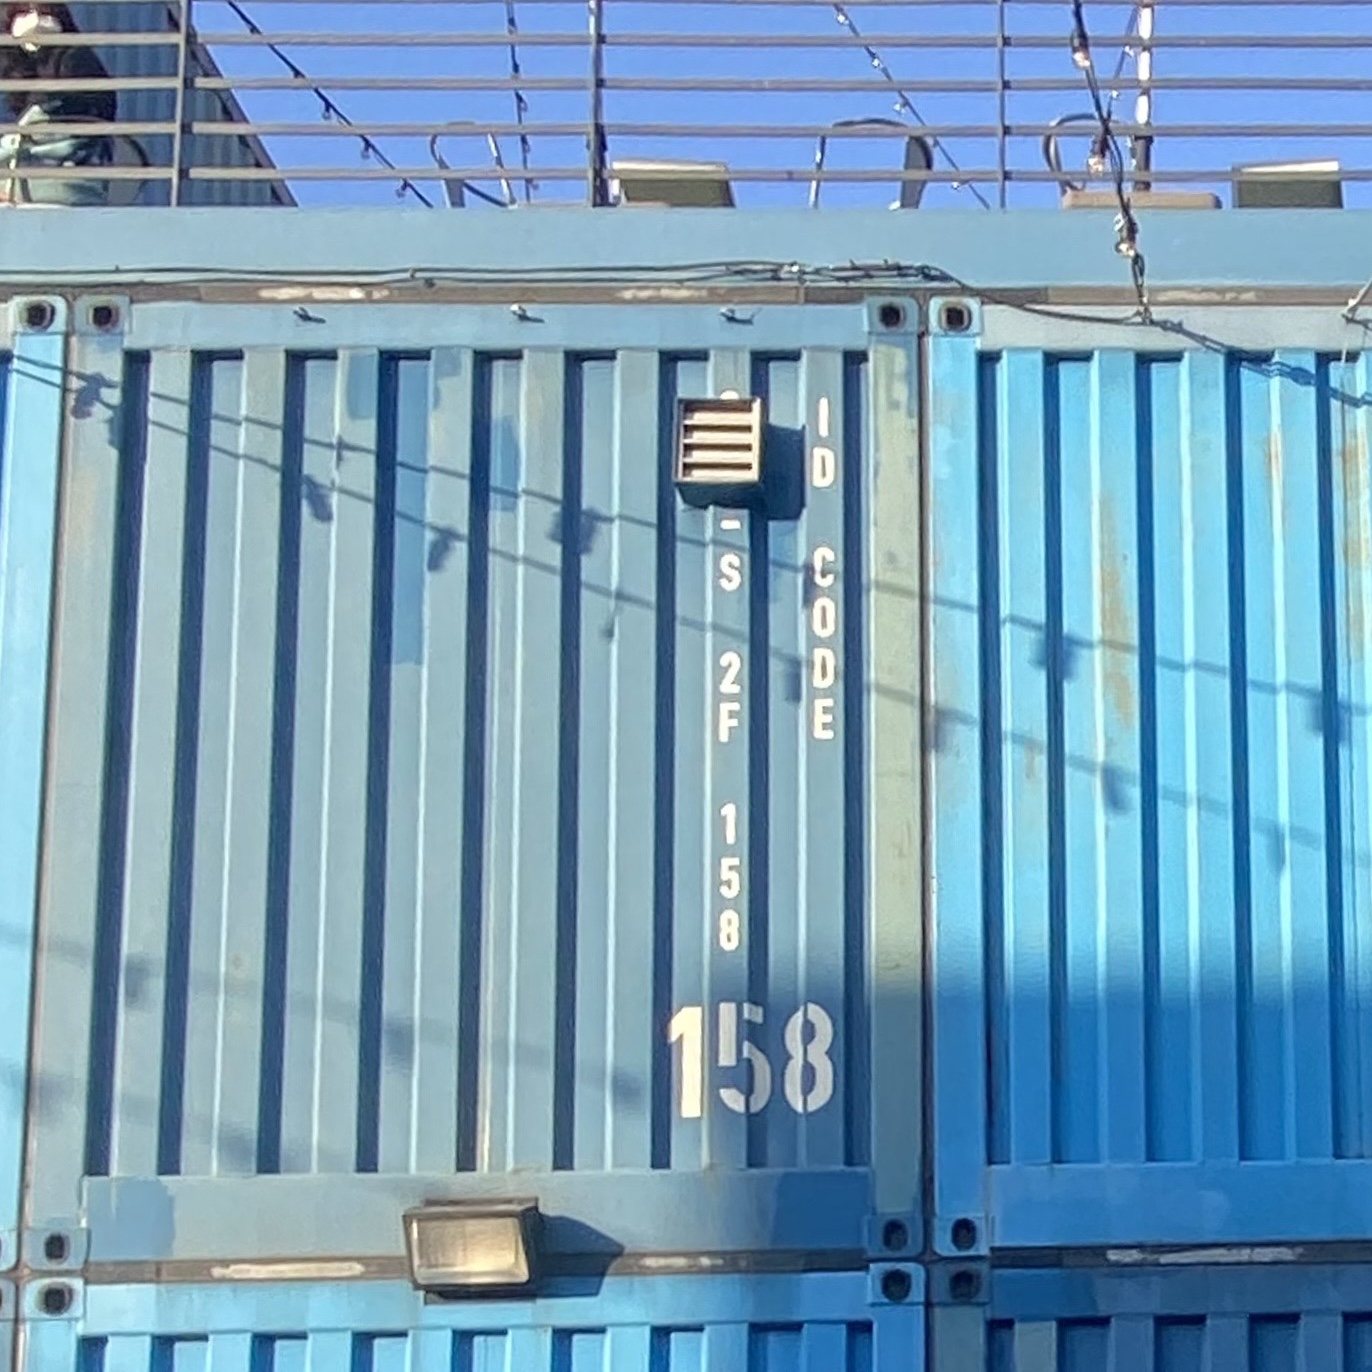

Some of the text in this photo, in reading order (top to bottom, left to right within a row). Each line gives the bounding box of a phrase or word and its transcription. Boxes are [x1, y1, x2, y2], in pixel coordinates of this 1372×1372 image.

[811, 397, 836, 739] ID CODE
[717, 652, 742, 742] 2F
[718, 803, 741, 951] 158
[668, 1002, 834, 1118] 158
